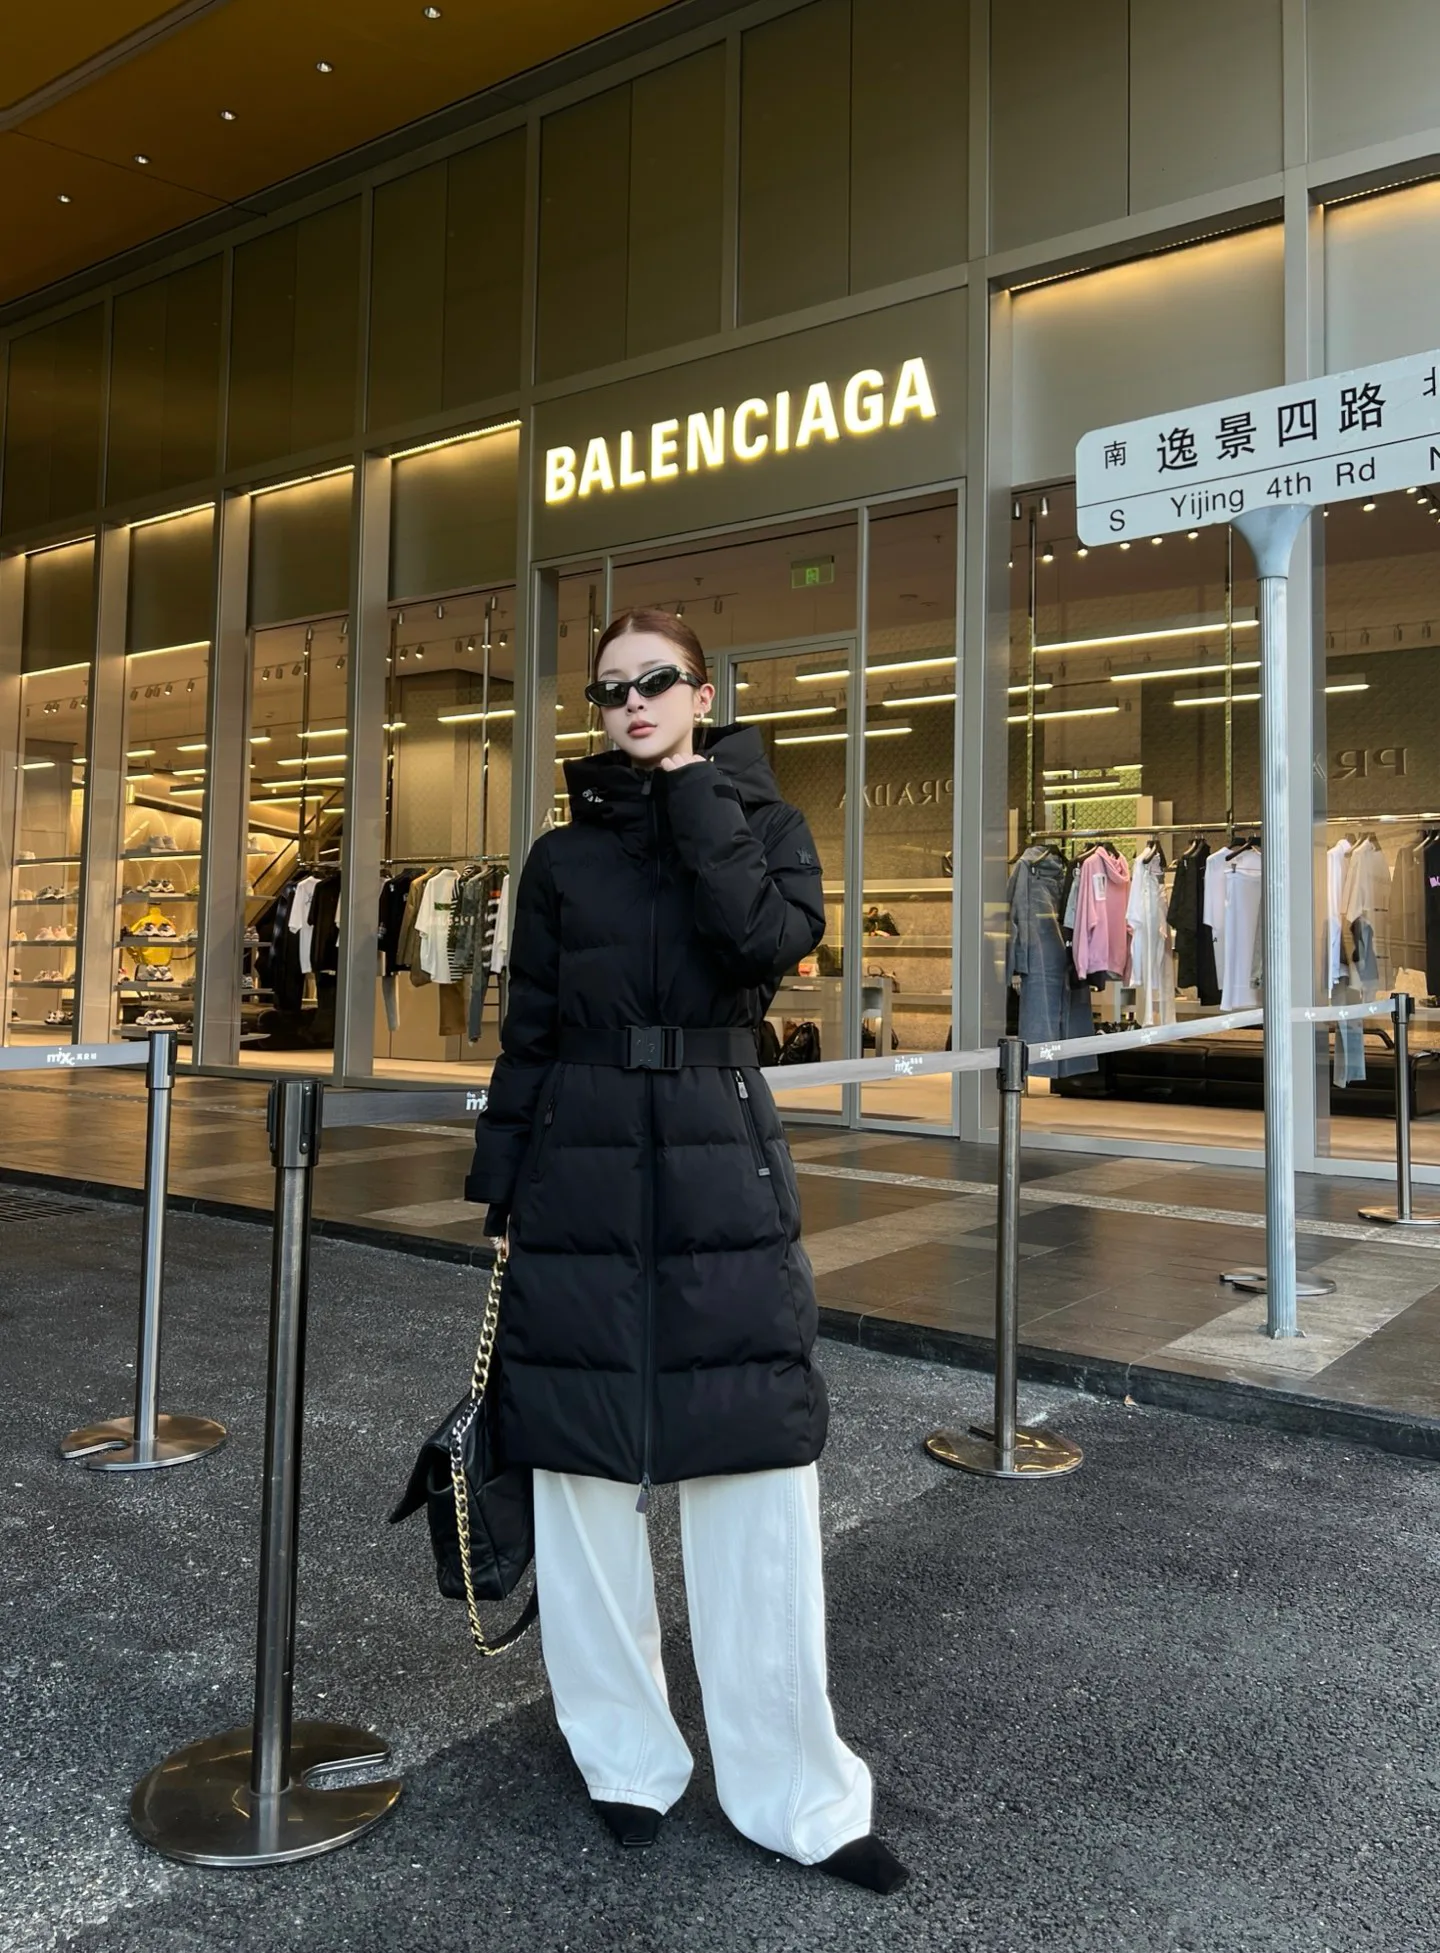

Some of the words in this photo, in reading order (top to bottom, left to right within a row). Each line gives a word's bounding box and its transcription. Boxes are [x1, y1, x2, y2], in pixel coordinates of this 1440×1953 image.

[545, 357, 938, 503] BALENCIAGA
[1104, 440, 1127, 469] 南
[1157, 383, 1386, 473] 逸景四路
[1109, 509, 1126, 531] S
[1171, 489, 1245, 520] Yijing
[1267, 471, 1312, 499] 4th
[1337, 458, 1376, 486] Rd
